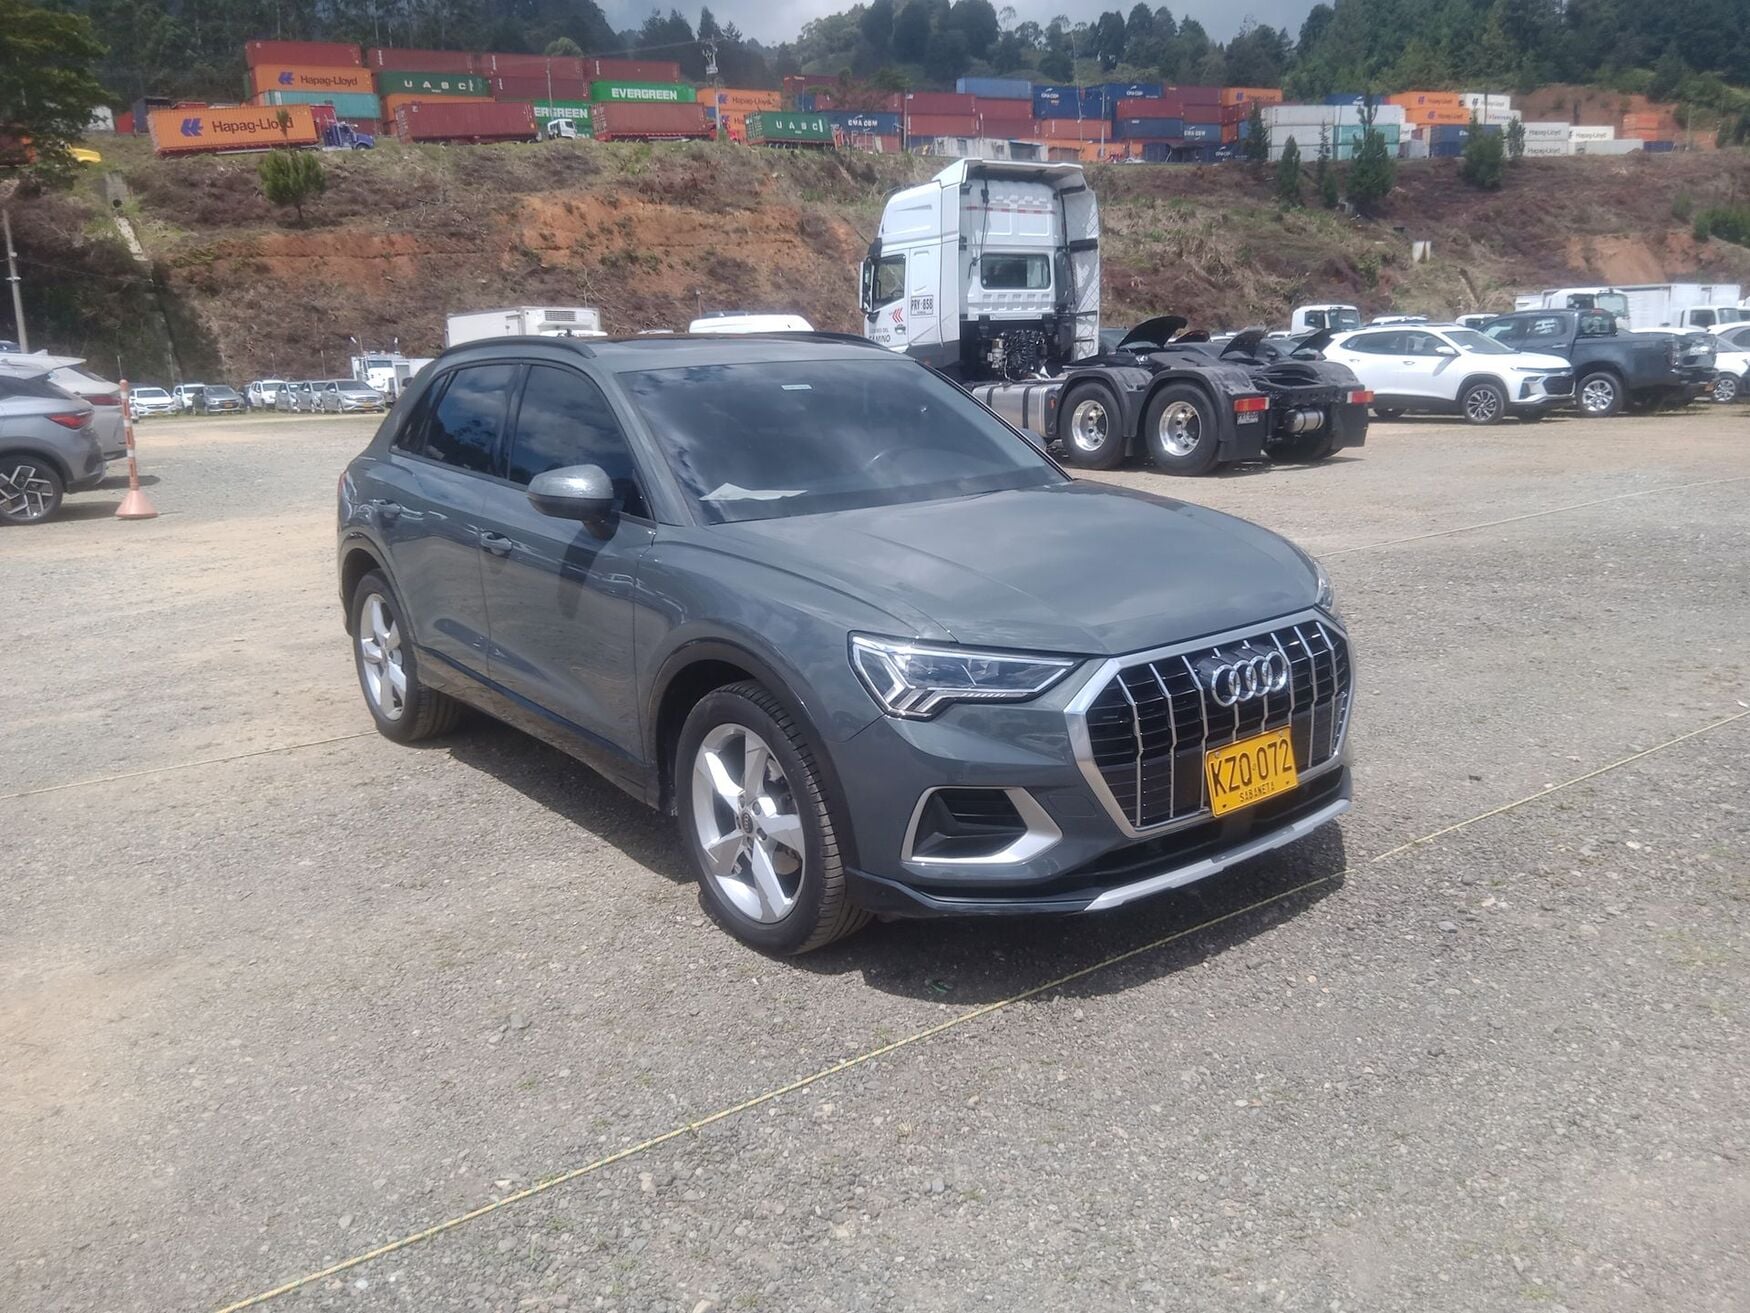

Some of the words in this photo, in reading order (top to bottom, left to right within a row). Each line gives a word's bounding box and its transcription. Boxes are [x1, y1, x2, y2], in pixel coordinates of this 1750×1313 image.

[300, 75, 358, 87] Hapag-Lloyd
[611, 87, 678, 100] EVERGREEN
[211, 116, 295, 134] Hapag-Llod
[1240, 782, 1274, 802] SABANETA
